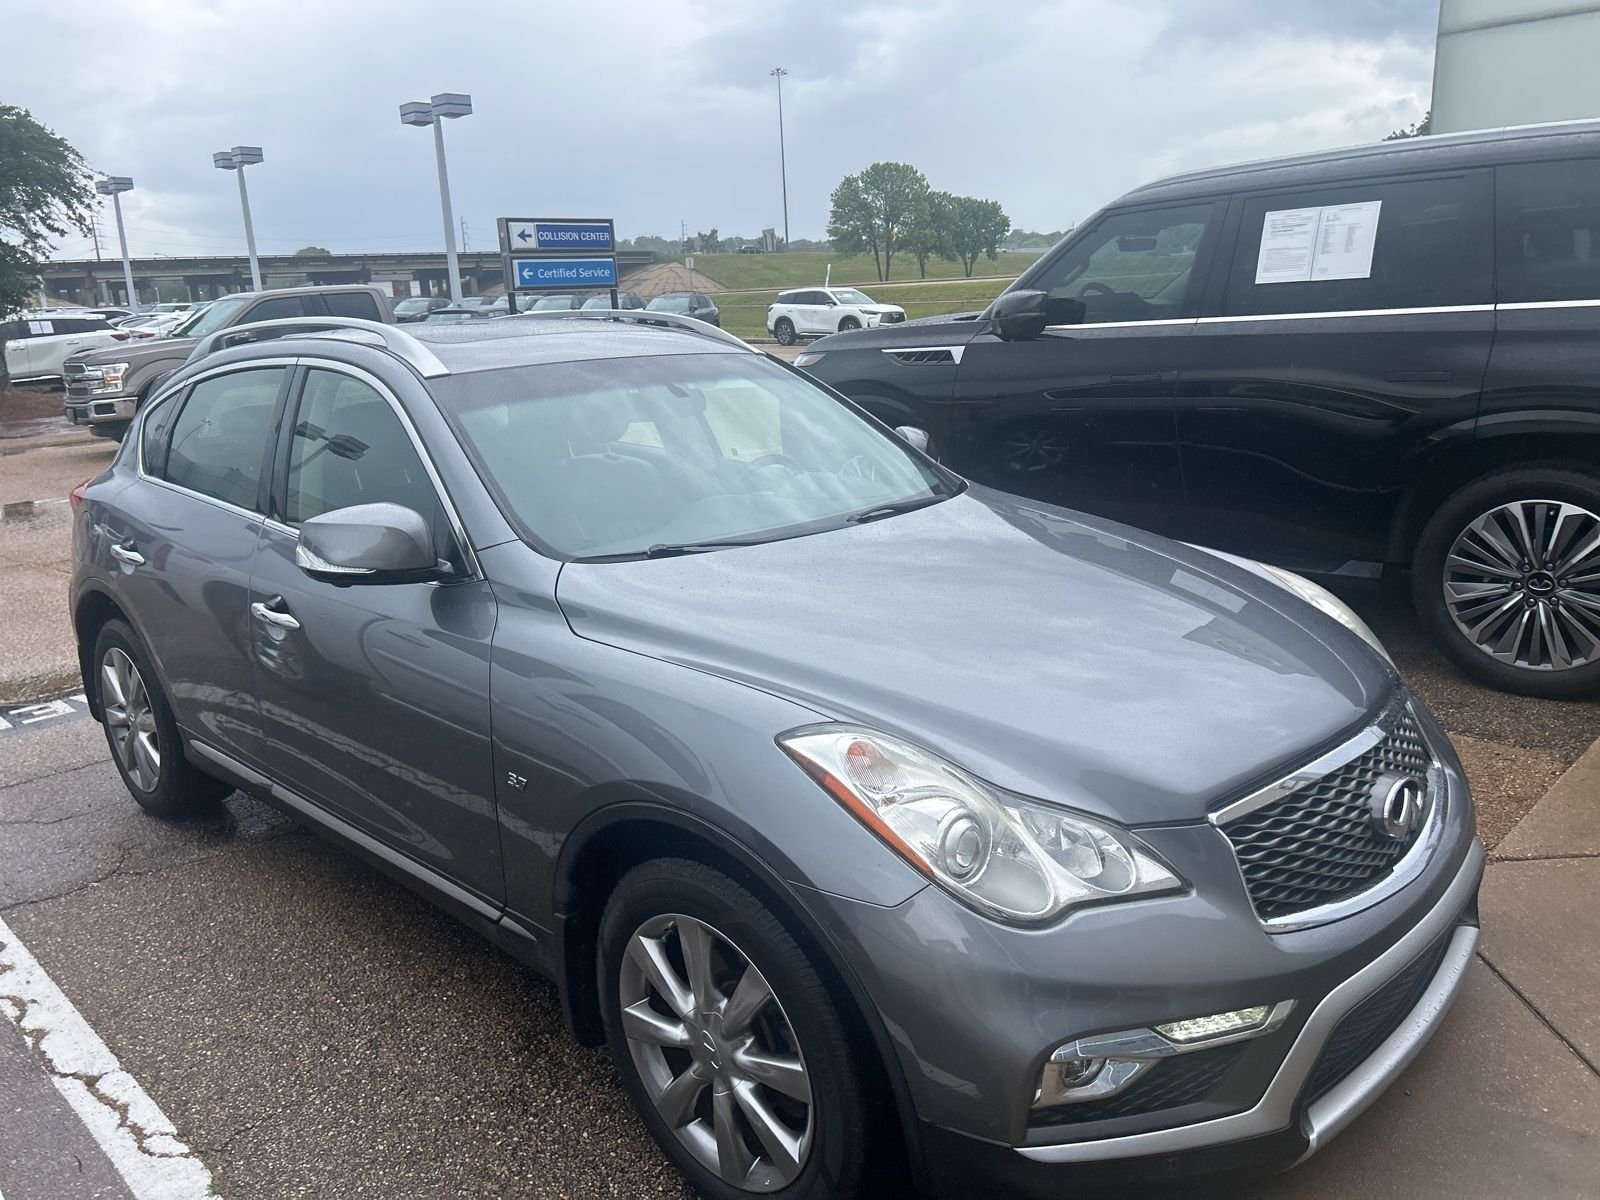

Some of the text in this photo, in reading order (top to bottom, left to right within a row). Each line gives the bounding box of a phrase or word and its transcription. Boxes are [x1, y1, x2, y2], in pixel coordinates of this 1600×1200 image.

[538, 231, 610, 241] COLLISION CENTER
[537, 267, 611, 278] Certified Service
